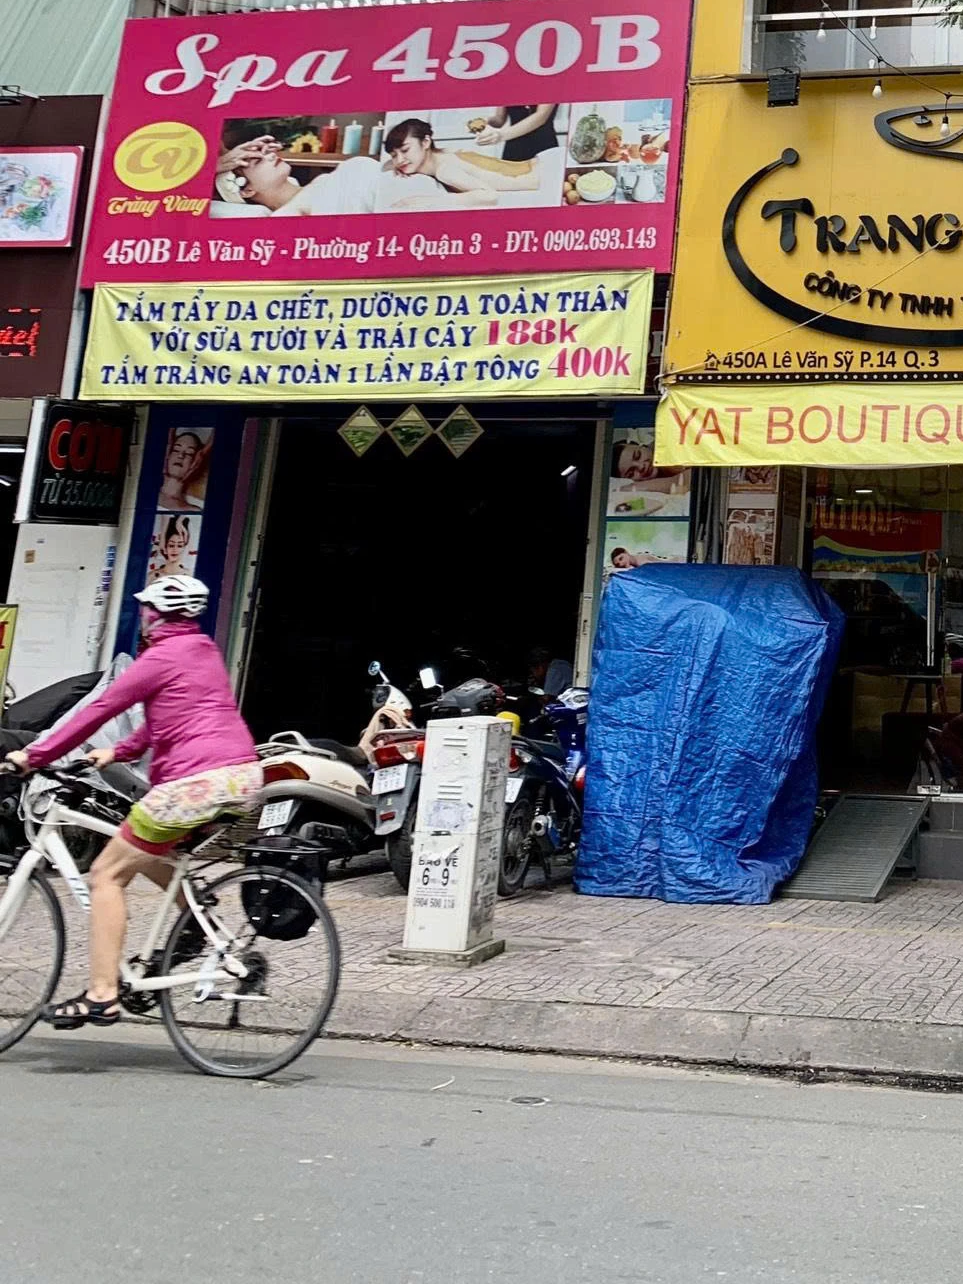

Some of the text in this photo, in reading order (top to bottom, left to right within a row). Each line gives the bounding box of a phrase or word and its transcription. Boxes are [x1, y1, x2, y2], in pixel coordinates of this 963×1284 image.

[144, 14, 662, 108] Spa 450B
[163, 195, 210, 216] Vàng
[103, 238, 171, 264] 450B
[176, 241, 200, 262] Lê
[208, 240, 245, 262] Văn
[250, 238, 275, 265] Sỹ
[292, 236, 371, 263] Phường
[409, 234, 464, 260] Quận
[469, 233, 482, 254] 3
[504, 230, 539, 253] ĐT:
[543, 227, 657, 252] 0902.693.143
[116, 284, 629, 323] TẮM TẨY DA CHẾT, DƯỠNG DA TOÀN THÂN
[803, 270, 862, 304] CÔNG
[867, 288, 893, 311] TY
[898, 292, 954, 317] TNHH
[150, 318, 580, 352] VỚI SỮA TƯƠI VÀ TRÁI CÂY 188k
[101, 346, 632, 387] TẮM TRẮNG AN TOÀN 1 LẦN BẬT TÔNG 400k
[723, 351, 767, 369] 450A
[772, 350, 792, 369] Lê
[796, 351, 828, 369] Văn
[833, 351, 855, 373] Sỹ
[860, 351, 897, 368] P.14
[670, 406, 753, 446] YAT
